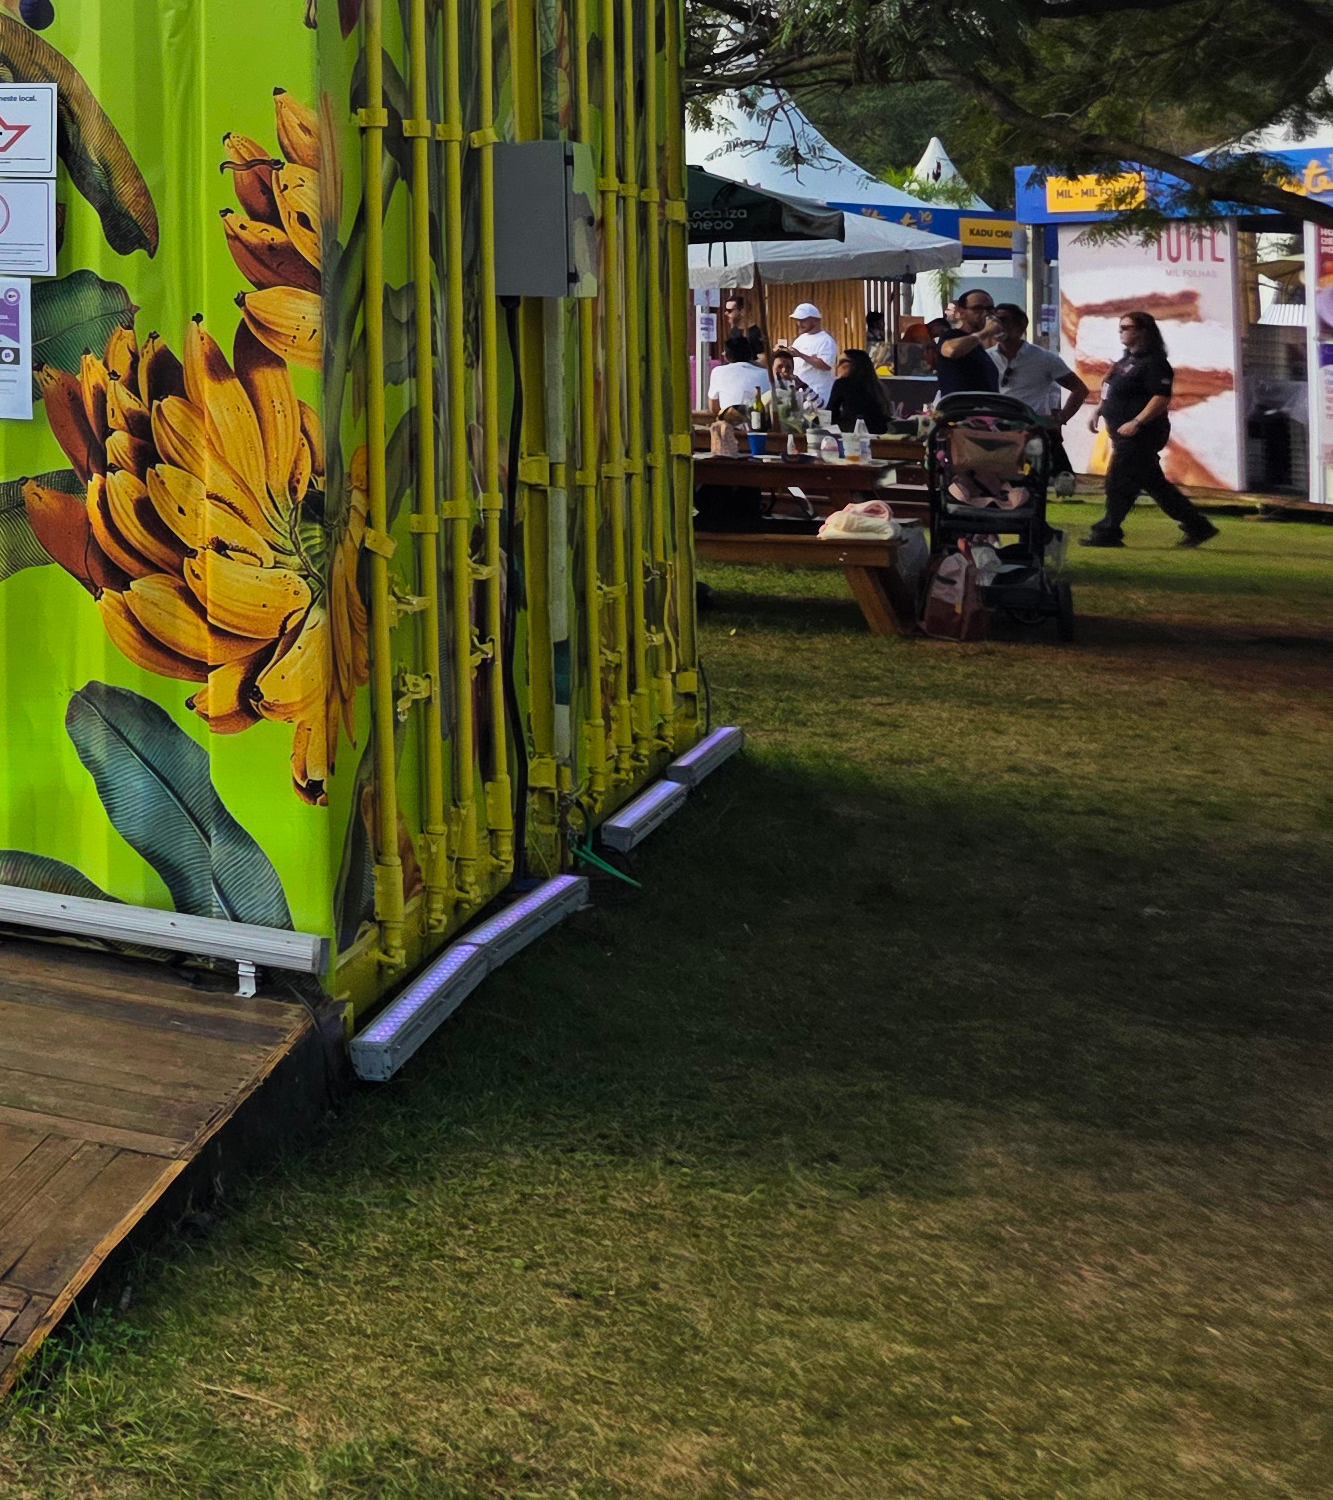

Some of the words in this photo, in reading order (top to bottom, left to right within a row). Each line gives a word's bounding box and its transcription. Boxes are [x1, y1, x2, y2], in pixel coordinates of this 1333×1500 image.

[1056, 189, 1073, 199] MIL
[1081, 189, 1098, 198] MIL
[969, 228, 993, 238] KADU
